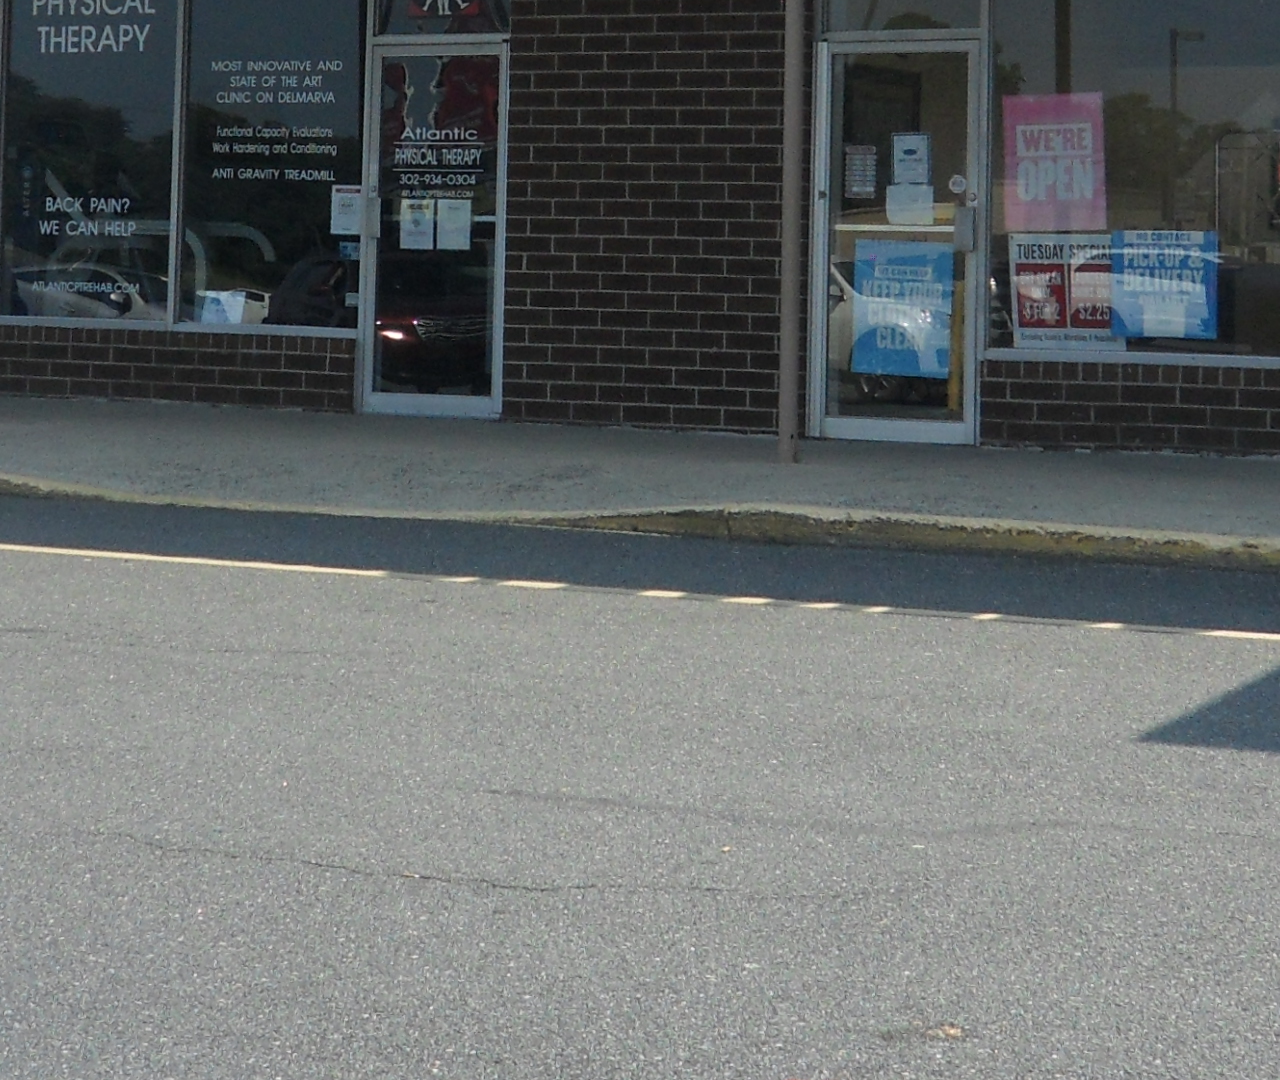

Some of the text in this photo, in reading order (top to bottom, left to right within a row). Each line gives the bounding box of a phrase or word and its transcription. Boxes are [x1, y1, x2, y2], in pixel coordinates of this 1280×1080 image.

[37, 24, 151, 53] THERAPY
[211, 60, 343, 72] MOST INNOVATIVE AND
[230, 76, 323, 88] STATE OF THE ART
[216, 91, 336, 104] CLINIC ON DELMARVA
[216, 125, 333, 139] Functional Capacity Evaluations
[400, 127, 479, 141] Atlantic
[1021, 127, 1088, 152] WE'RE
[212, 142, 338, 157] Work Hardening and Conditioning
[394, 148, 482, 166] PHYSICAL THERAPY
[212, 168, 336, 181] ANTI GRAVITY TREADMILL
[399, 174, 476, 186] 302-934-0304
[1017, 160, 1094, 200] OPEN
[45, 197, 130, 214] BACK PAIN?
[39, 220, 136, 238] WE CAN HELP
[1016, 243, 1065, 260] TUESDAY
[1123, 246, 1205, 268] PICK-UP &
[1123, 268, 1204, 291] DELIVERY
[862, 280, 901, 298] KEEP
[1078, 303, 1111, 320] $2.25
